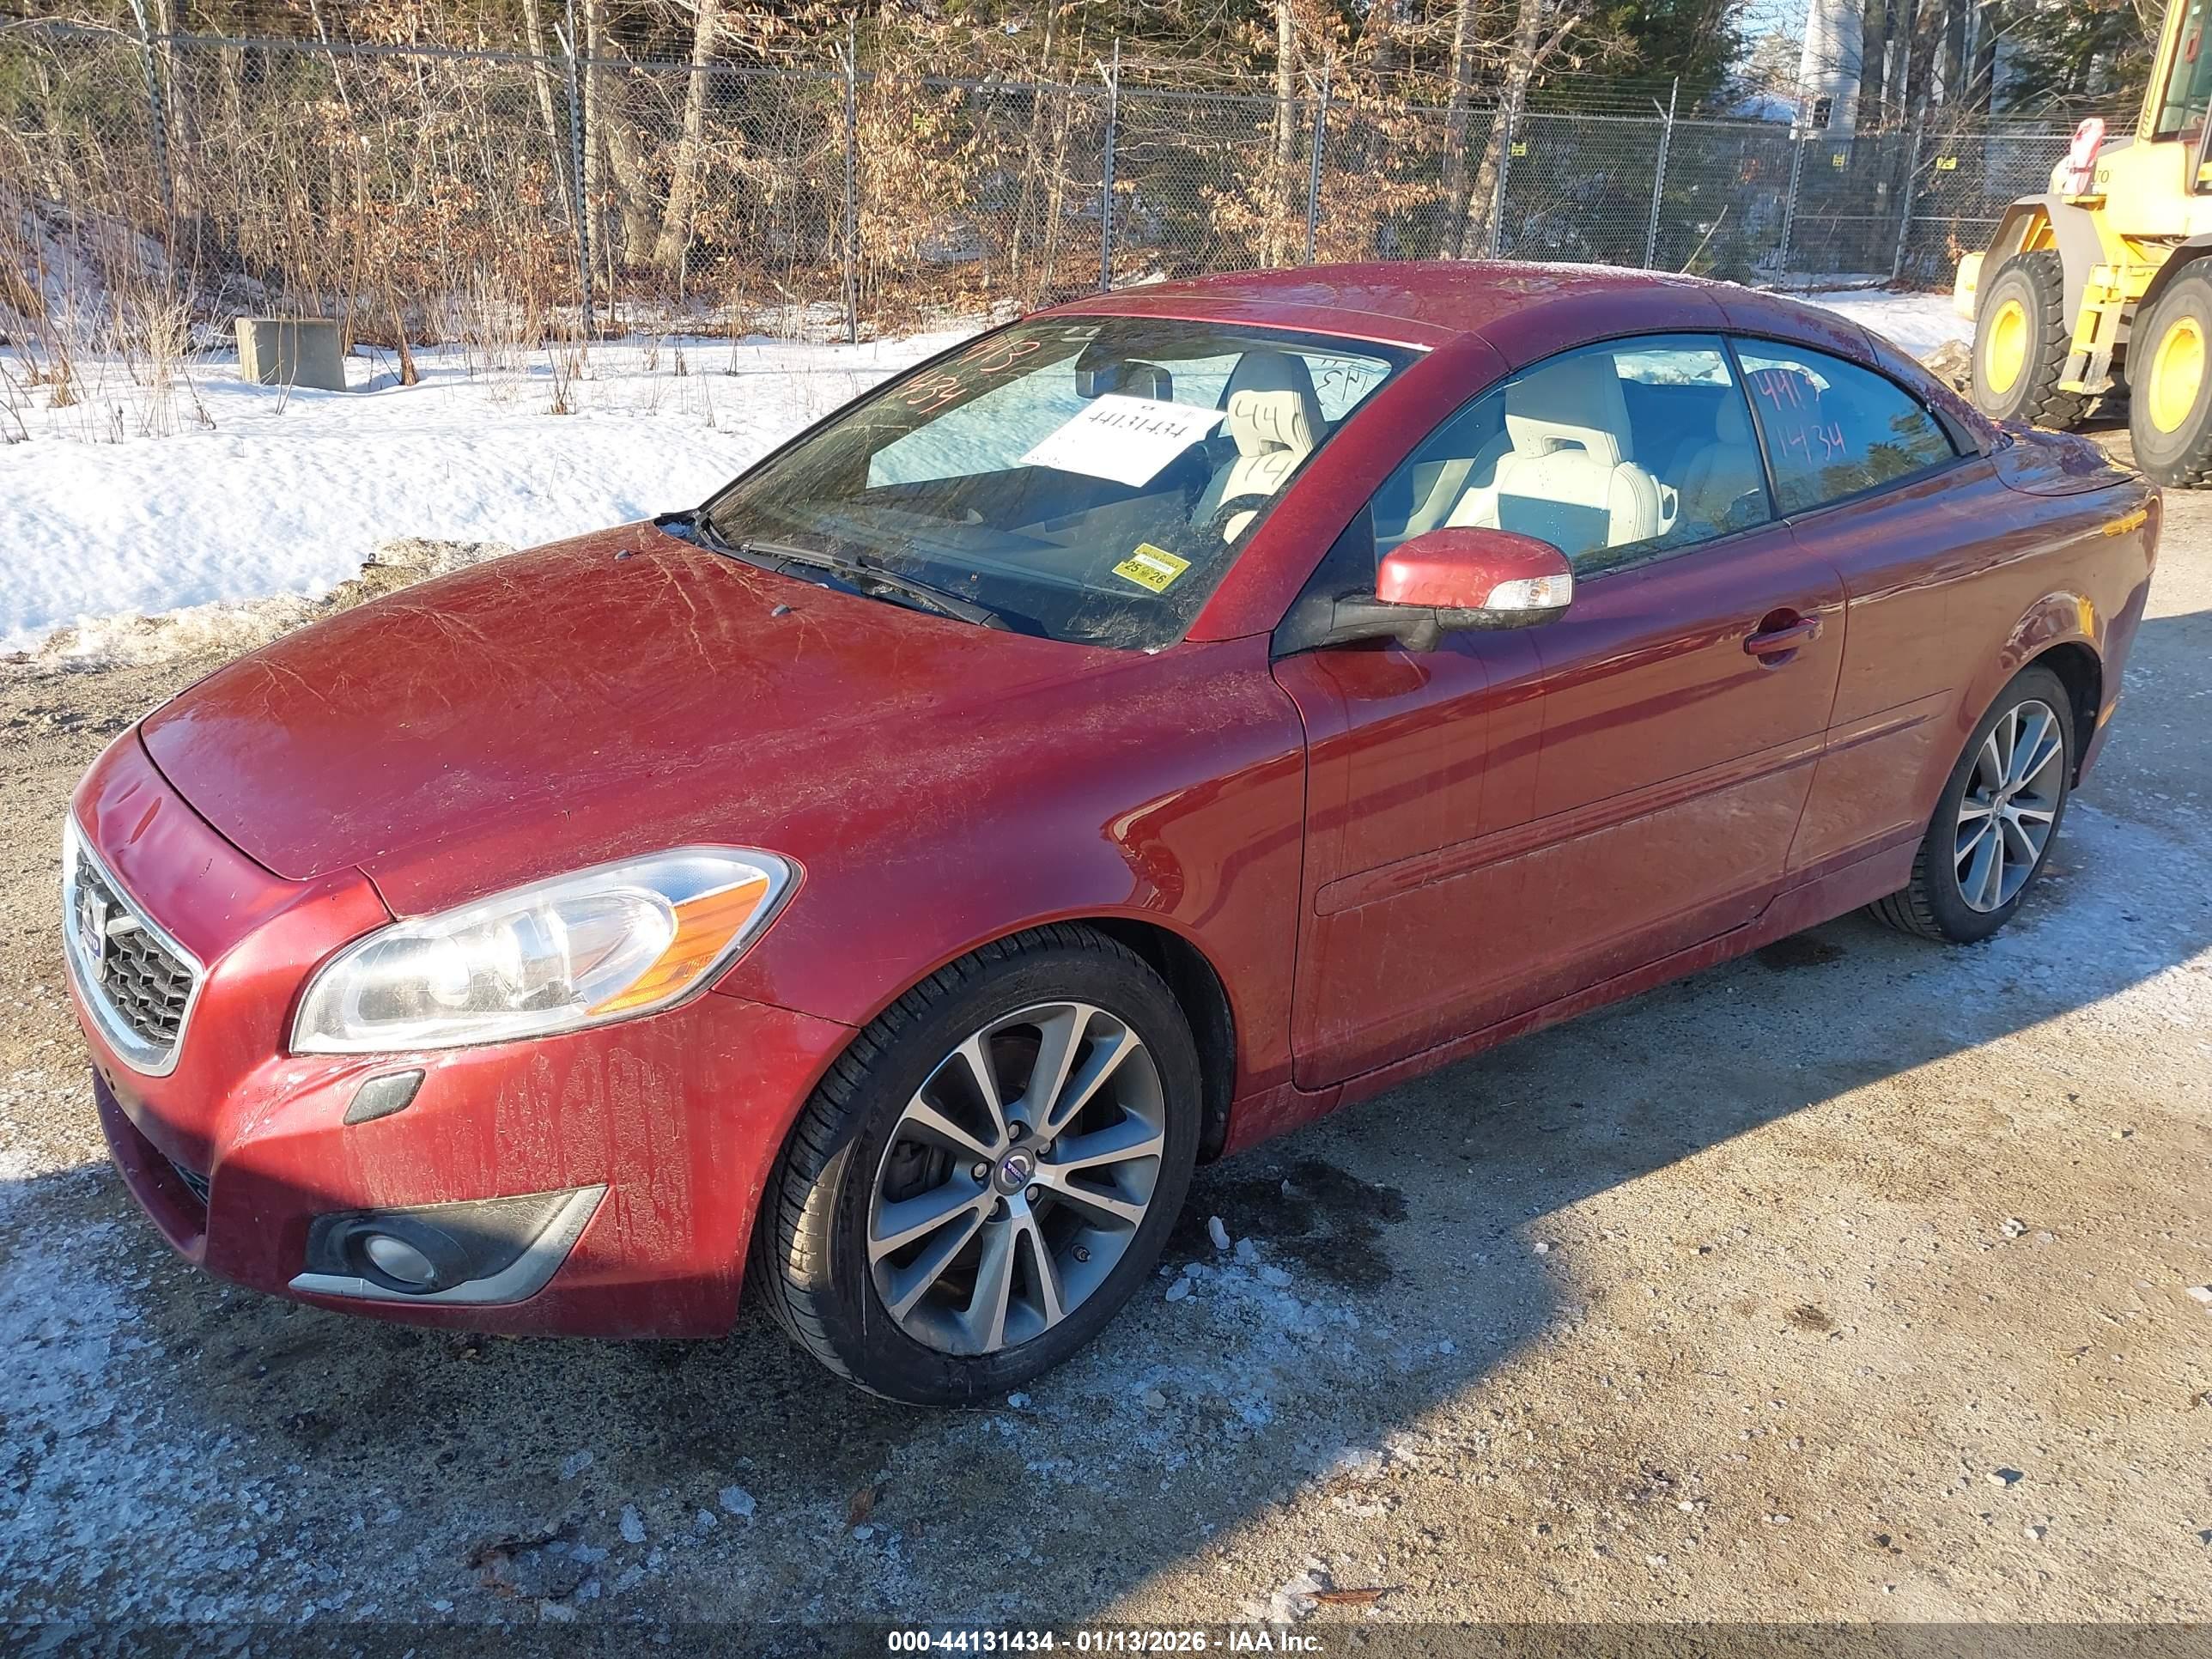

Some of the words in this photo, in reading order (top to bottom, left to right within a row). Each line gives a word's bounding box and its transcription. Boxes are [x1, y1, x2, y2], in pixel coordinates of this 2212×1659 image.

[1776, 422, 1847, 465] 1434
[1124, 561, 1142, 573] 25
[1148, 571, 1167, 584] 26
